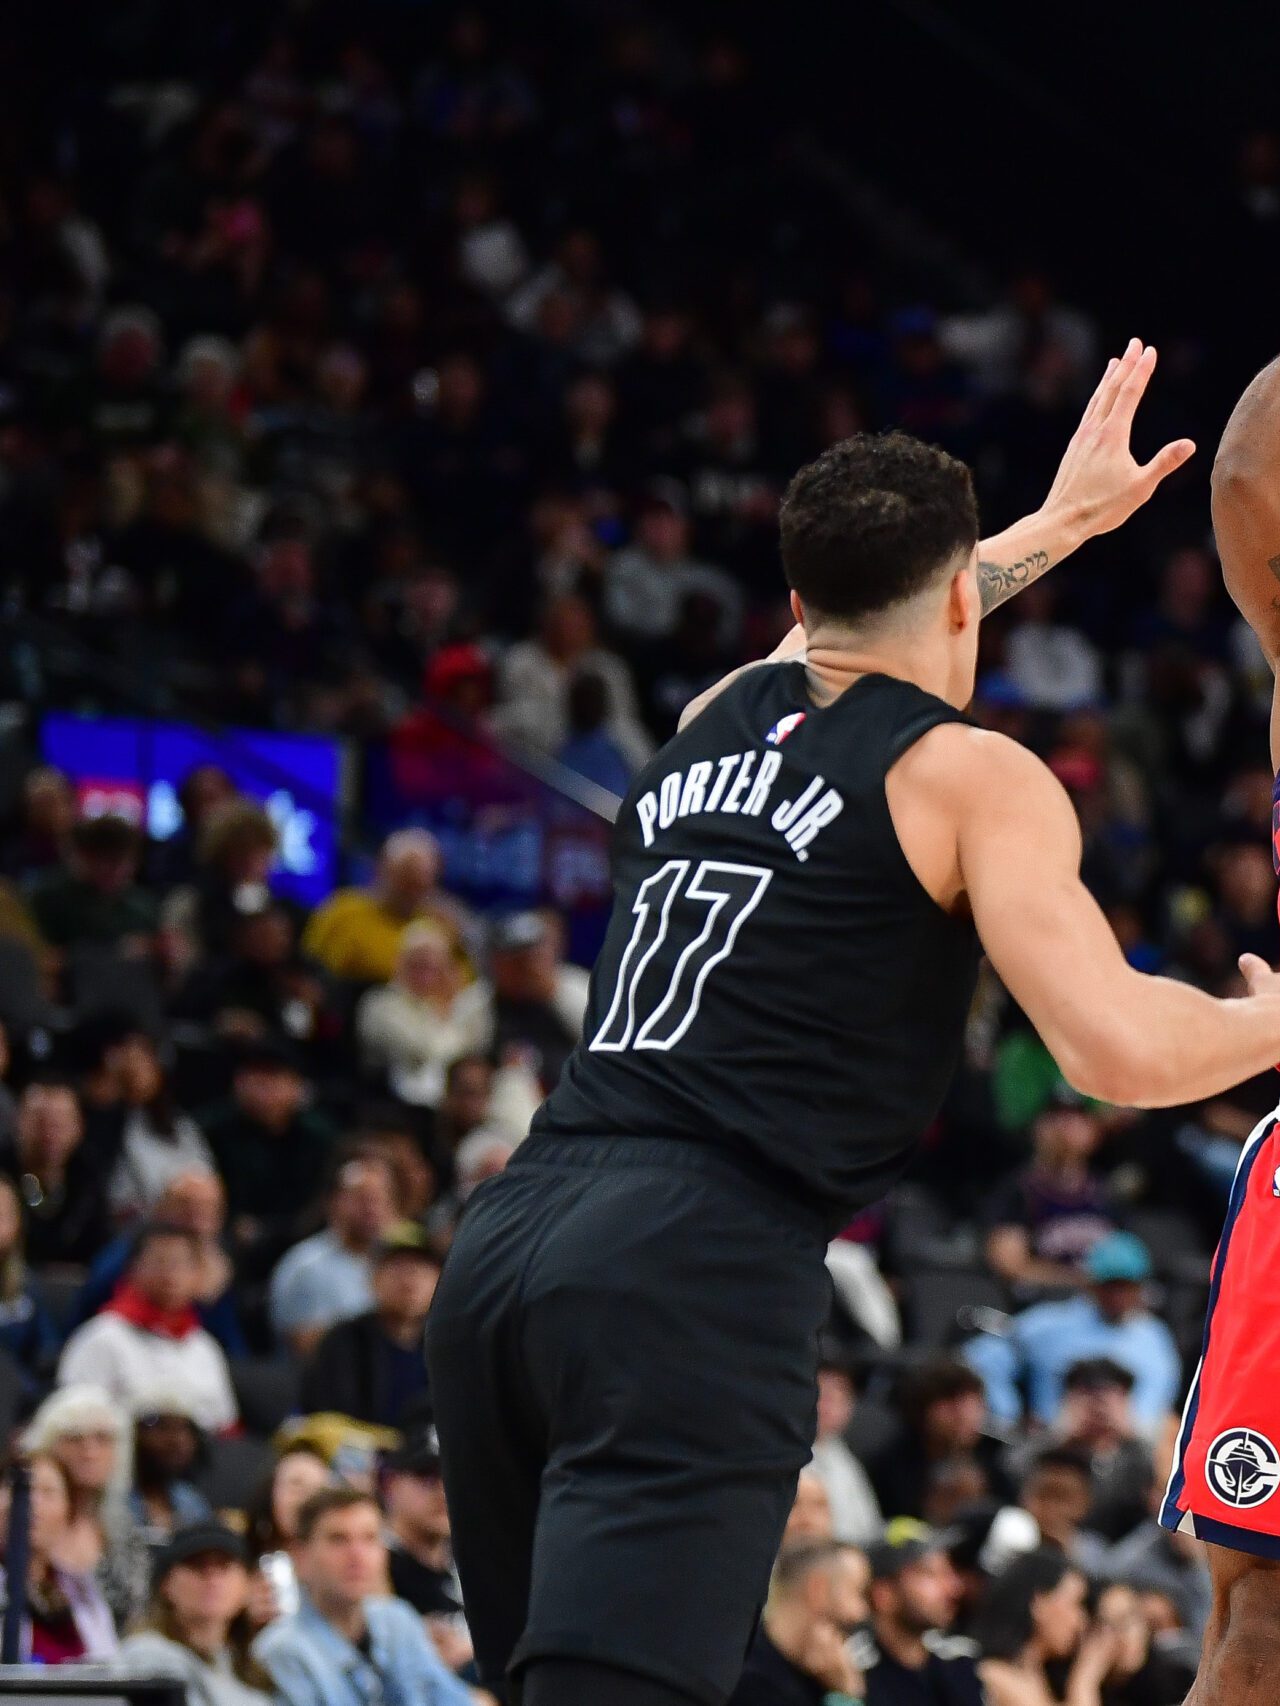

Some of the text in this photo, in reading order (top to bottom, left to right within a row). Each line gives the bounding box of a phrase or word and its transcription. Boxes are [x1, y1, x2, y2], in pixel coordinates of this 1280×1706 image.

[636, 750, 844, 862] PORTER JR.
[588, 860, 774, 1052] 17
